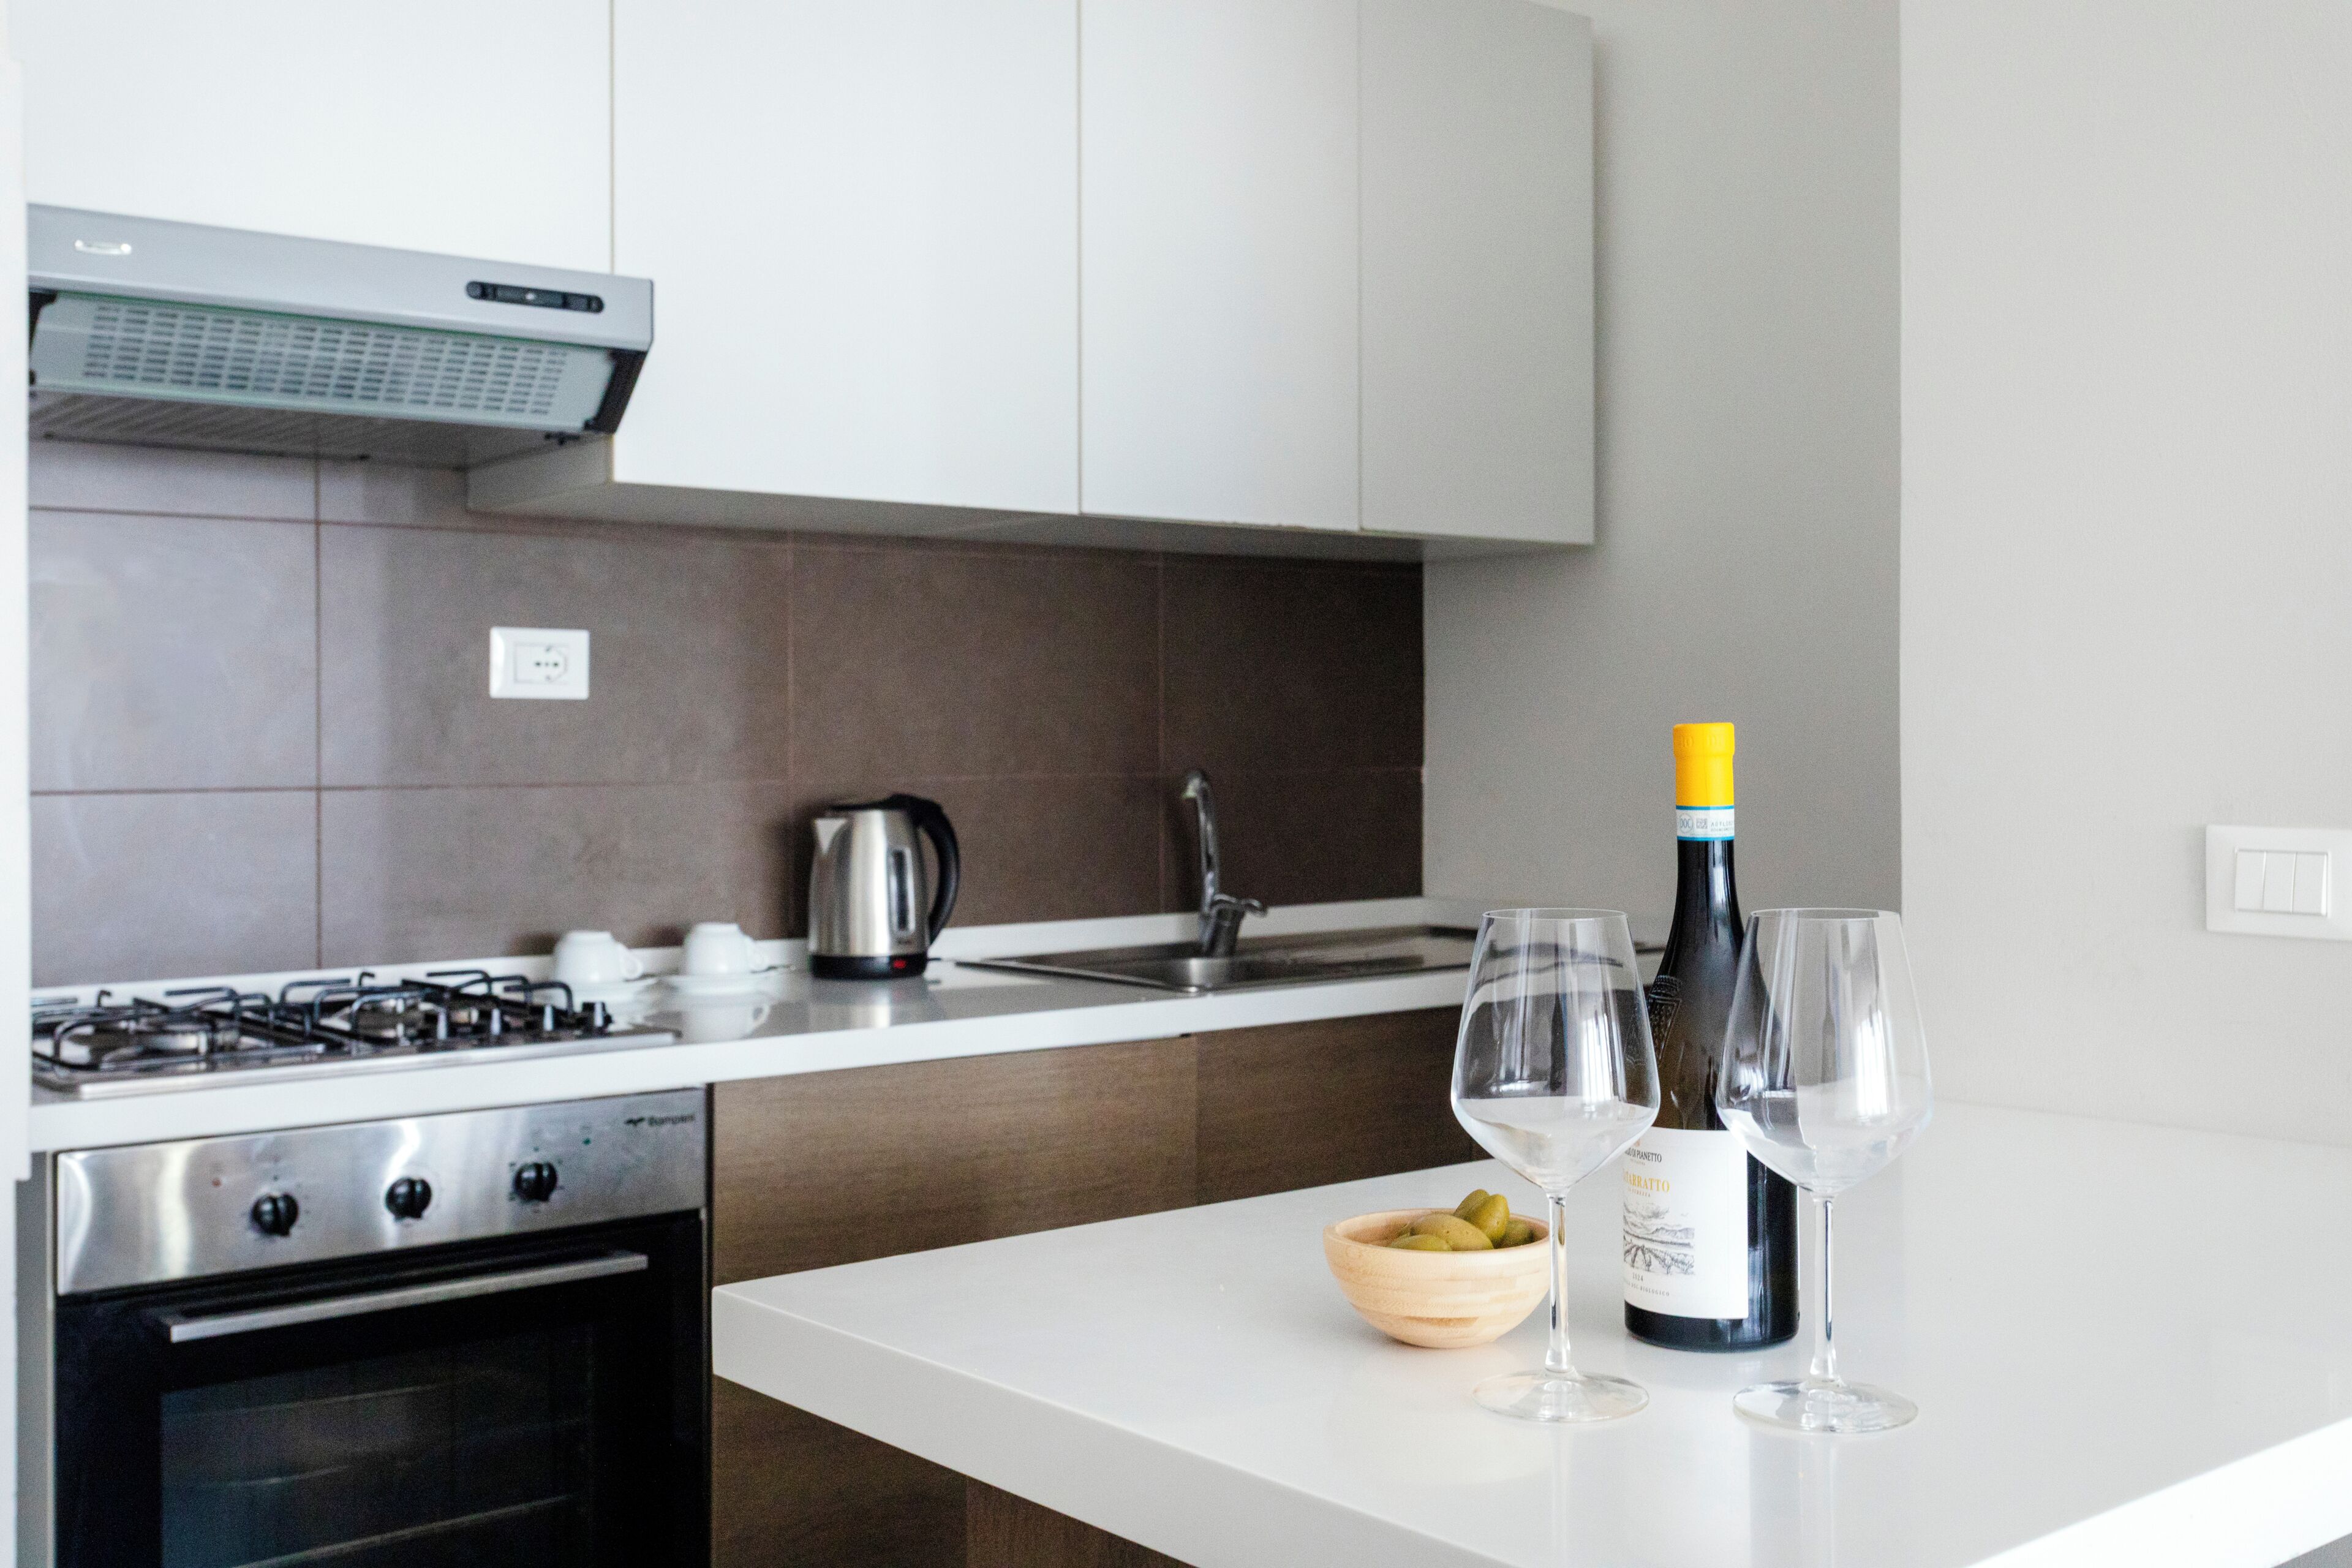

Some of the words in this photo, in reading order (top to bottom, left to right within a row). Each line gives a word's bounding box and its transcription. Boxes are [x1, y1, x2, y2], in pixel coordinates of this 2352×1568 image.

[1680, 818, 1691, 828] DOC
[1636, 1149, 1662, 1163] PIANETTO
[1640, 1285, 1670, 1297] BIOLOGICO
